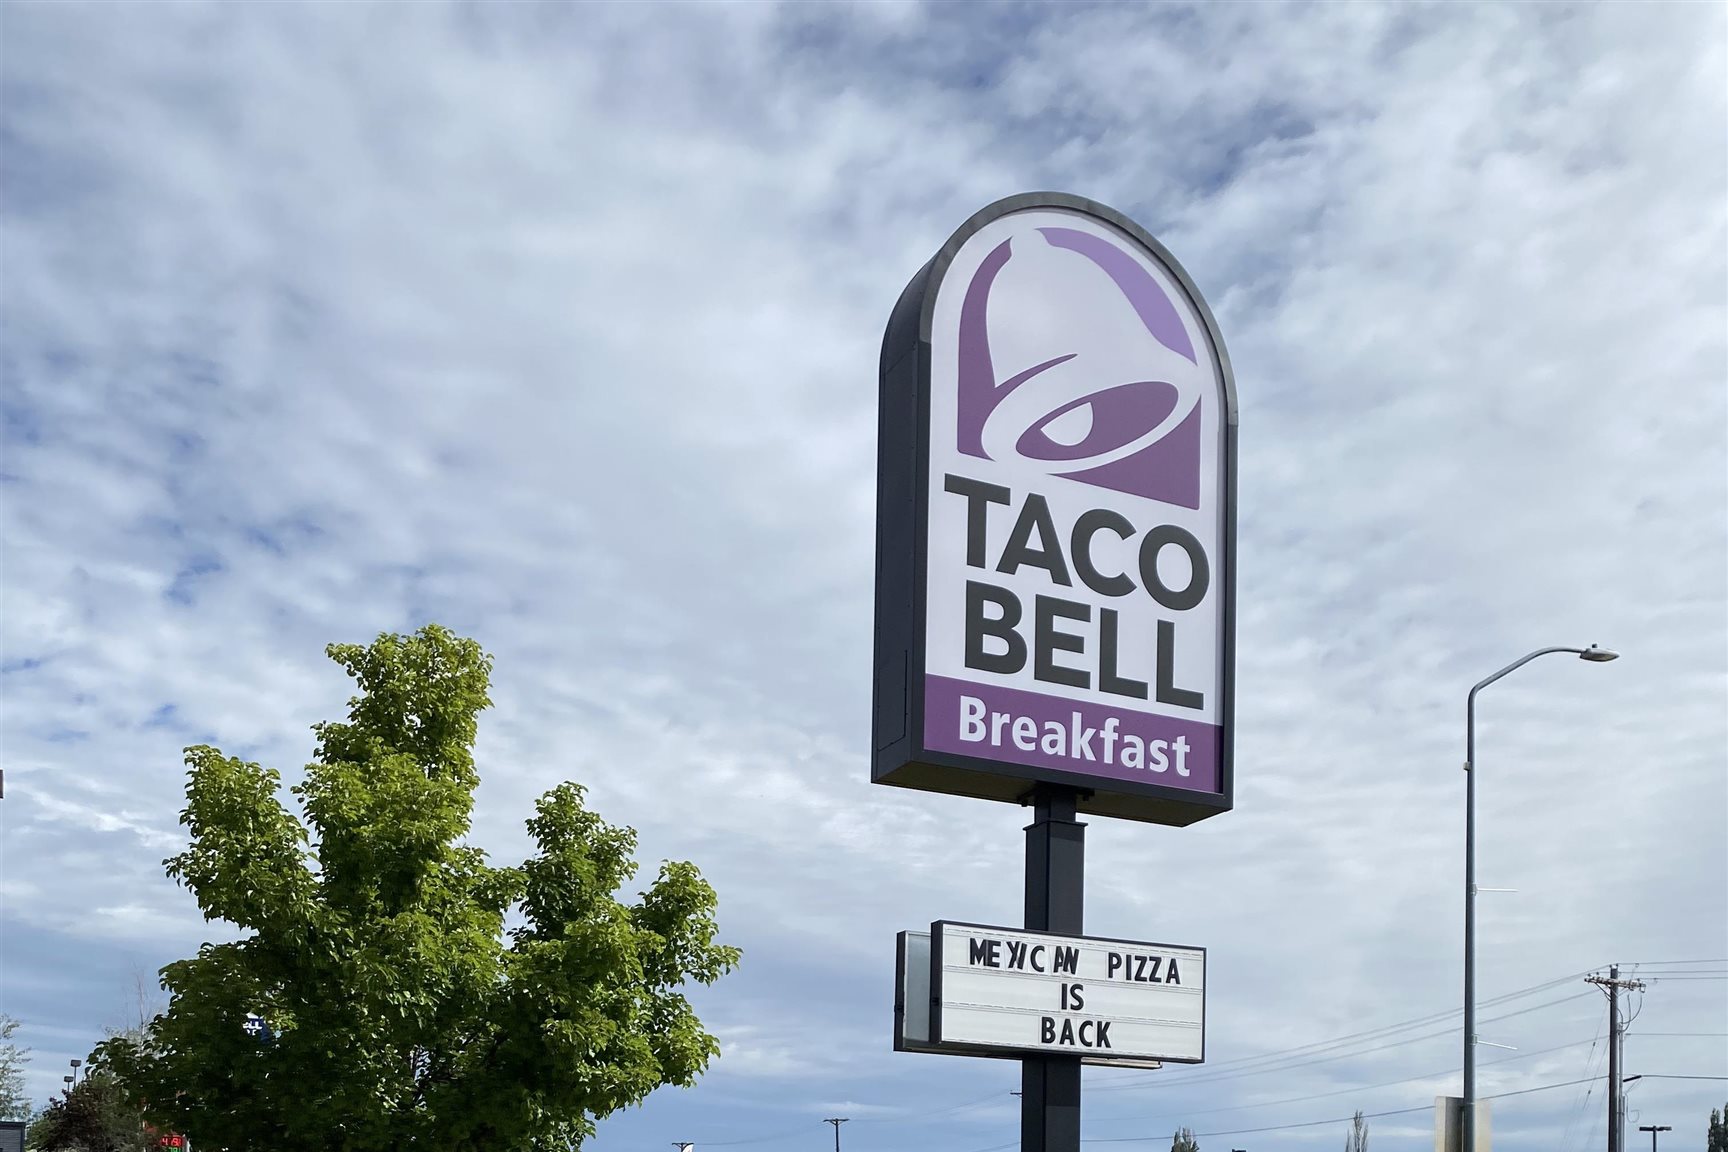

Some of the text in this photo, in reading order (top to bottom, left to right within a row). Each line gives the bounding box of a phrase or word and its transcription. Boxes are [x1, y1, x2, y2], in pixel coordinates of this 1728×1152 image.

[944, 473, 1210, 611] TACO
[965, 580, 1204, 710] BELL
[959, 695, 1190, 777] Breakfast
[1061, 983, 1084, 1011] IS
[1108, 953, 1181, 985] PIZZA
[1041, 1016, 1112, 1048] BACK
